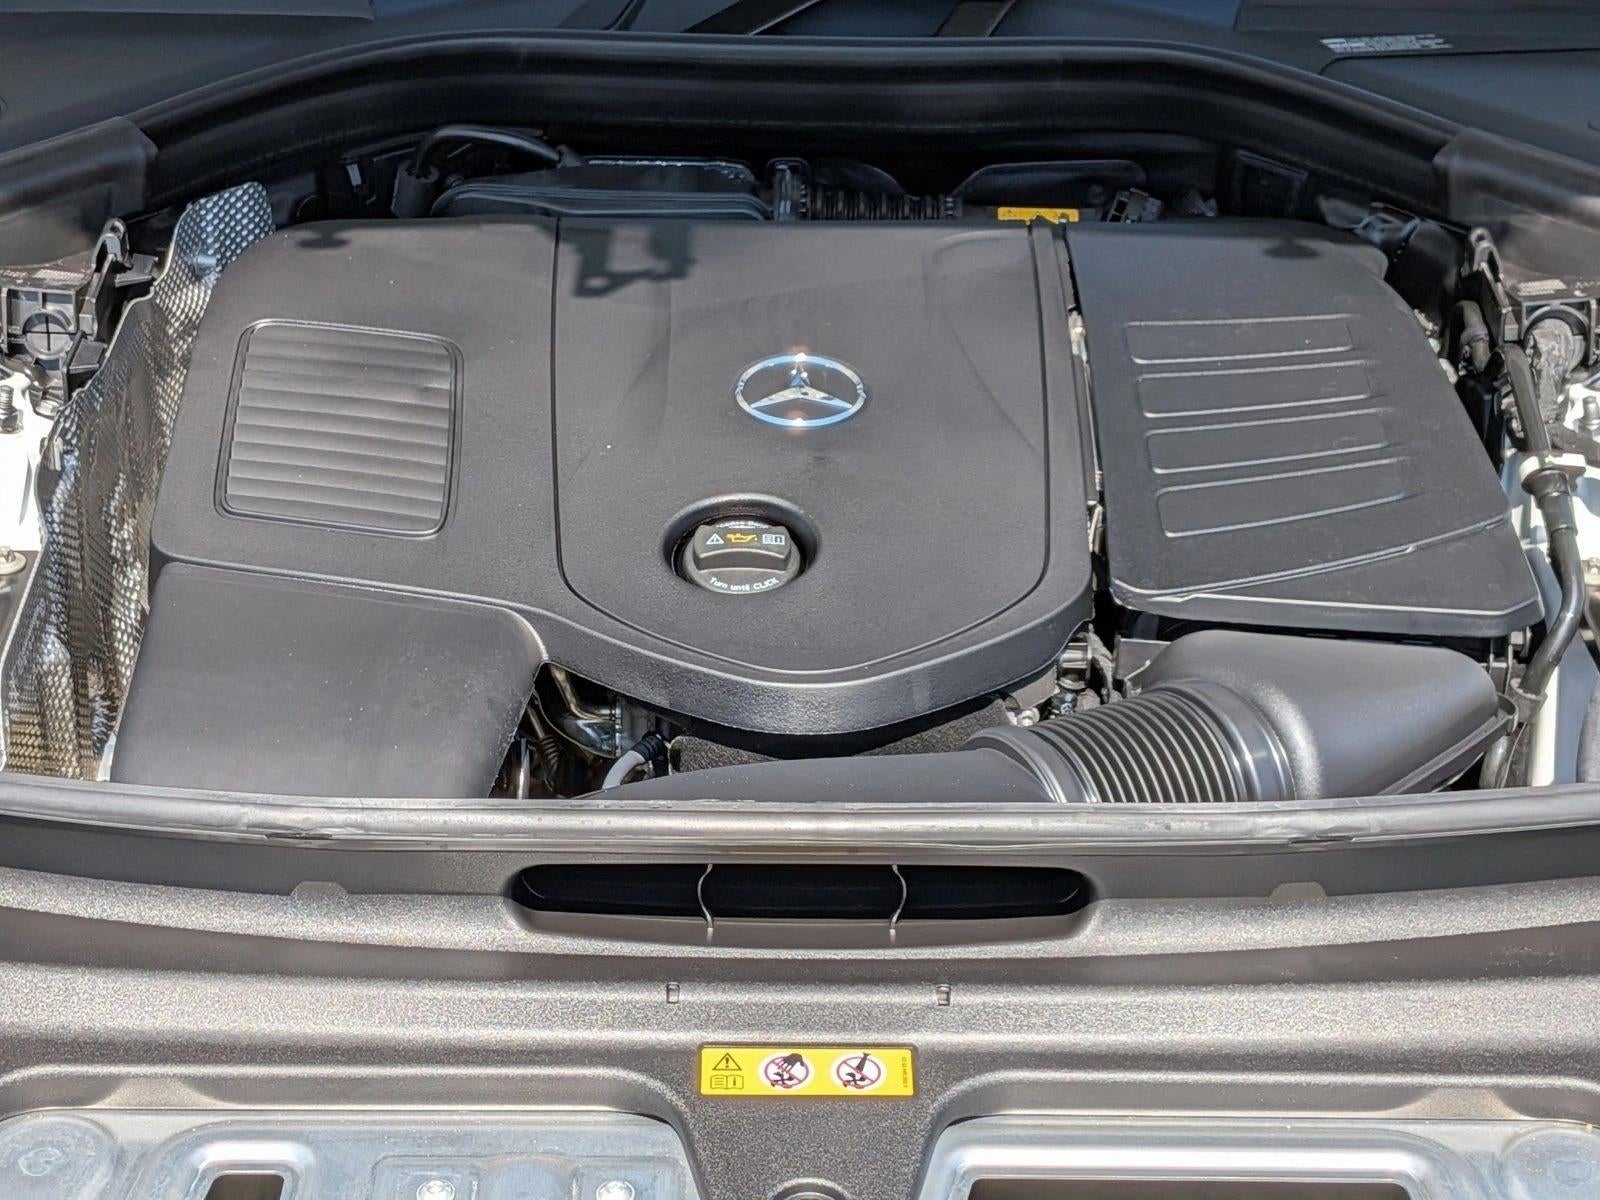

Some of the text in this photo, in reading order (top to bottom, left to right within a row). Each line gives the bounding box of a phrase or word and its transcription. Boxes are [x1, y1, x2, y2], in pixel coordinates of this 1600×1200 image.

[709, 576, 779, 591] Turn until CLICK
